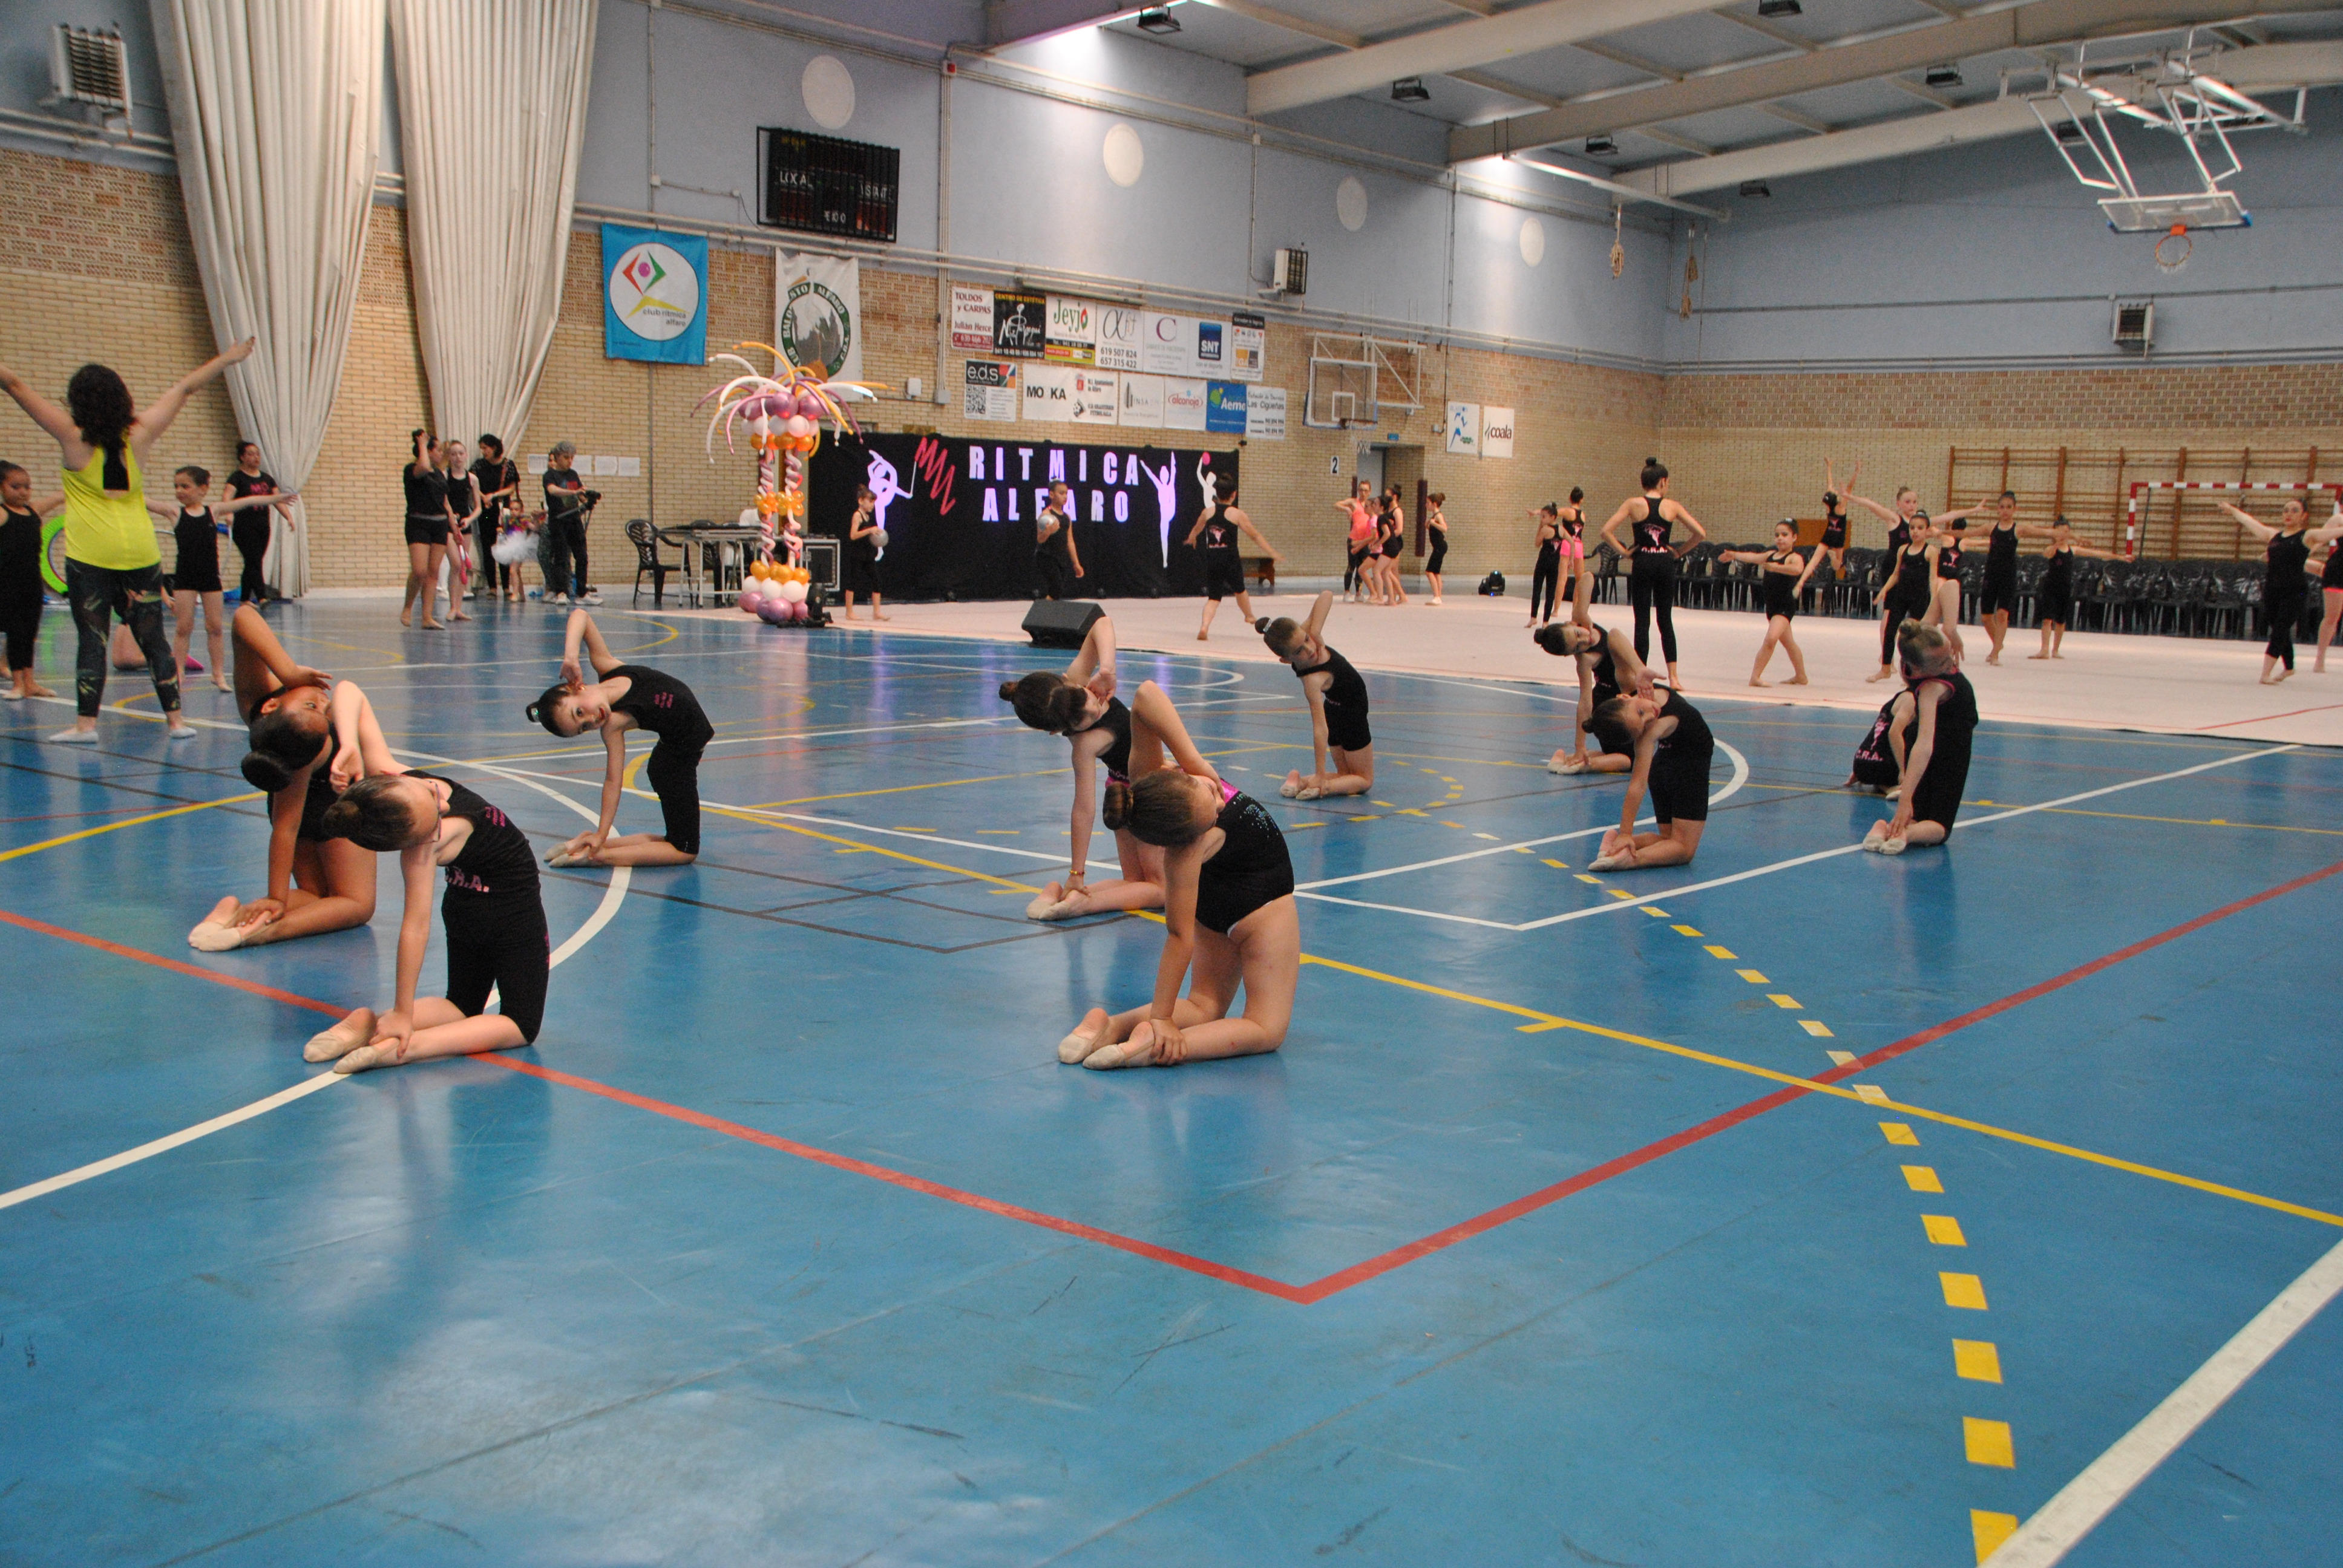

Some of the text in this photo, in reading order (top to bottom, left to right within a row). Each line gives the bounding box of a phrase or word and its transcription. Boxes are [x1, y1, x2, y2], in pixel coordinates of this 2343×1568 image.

[955, 292, 983, 302] TOLDOS
[964, 304, 991, 313] CARPAS
[1114, 348, 1124, 358] 507
[1126, 350, 1137, 358] 824
[1201, 340, 1219, 353] SNT
[1114, 358, 1124, 367] 315
[1126, 359, 1137, 368] 422
[1027, 385, 1066, 399] MO KA
[1490, 424, 1512, 439] coala
[969, 446, 1139, 486] RITMICA
[1332, 457, 1338, 474] 2
